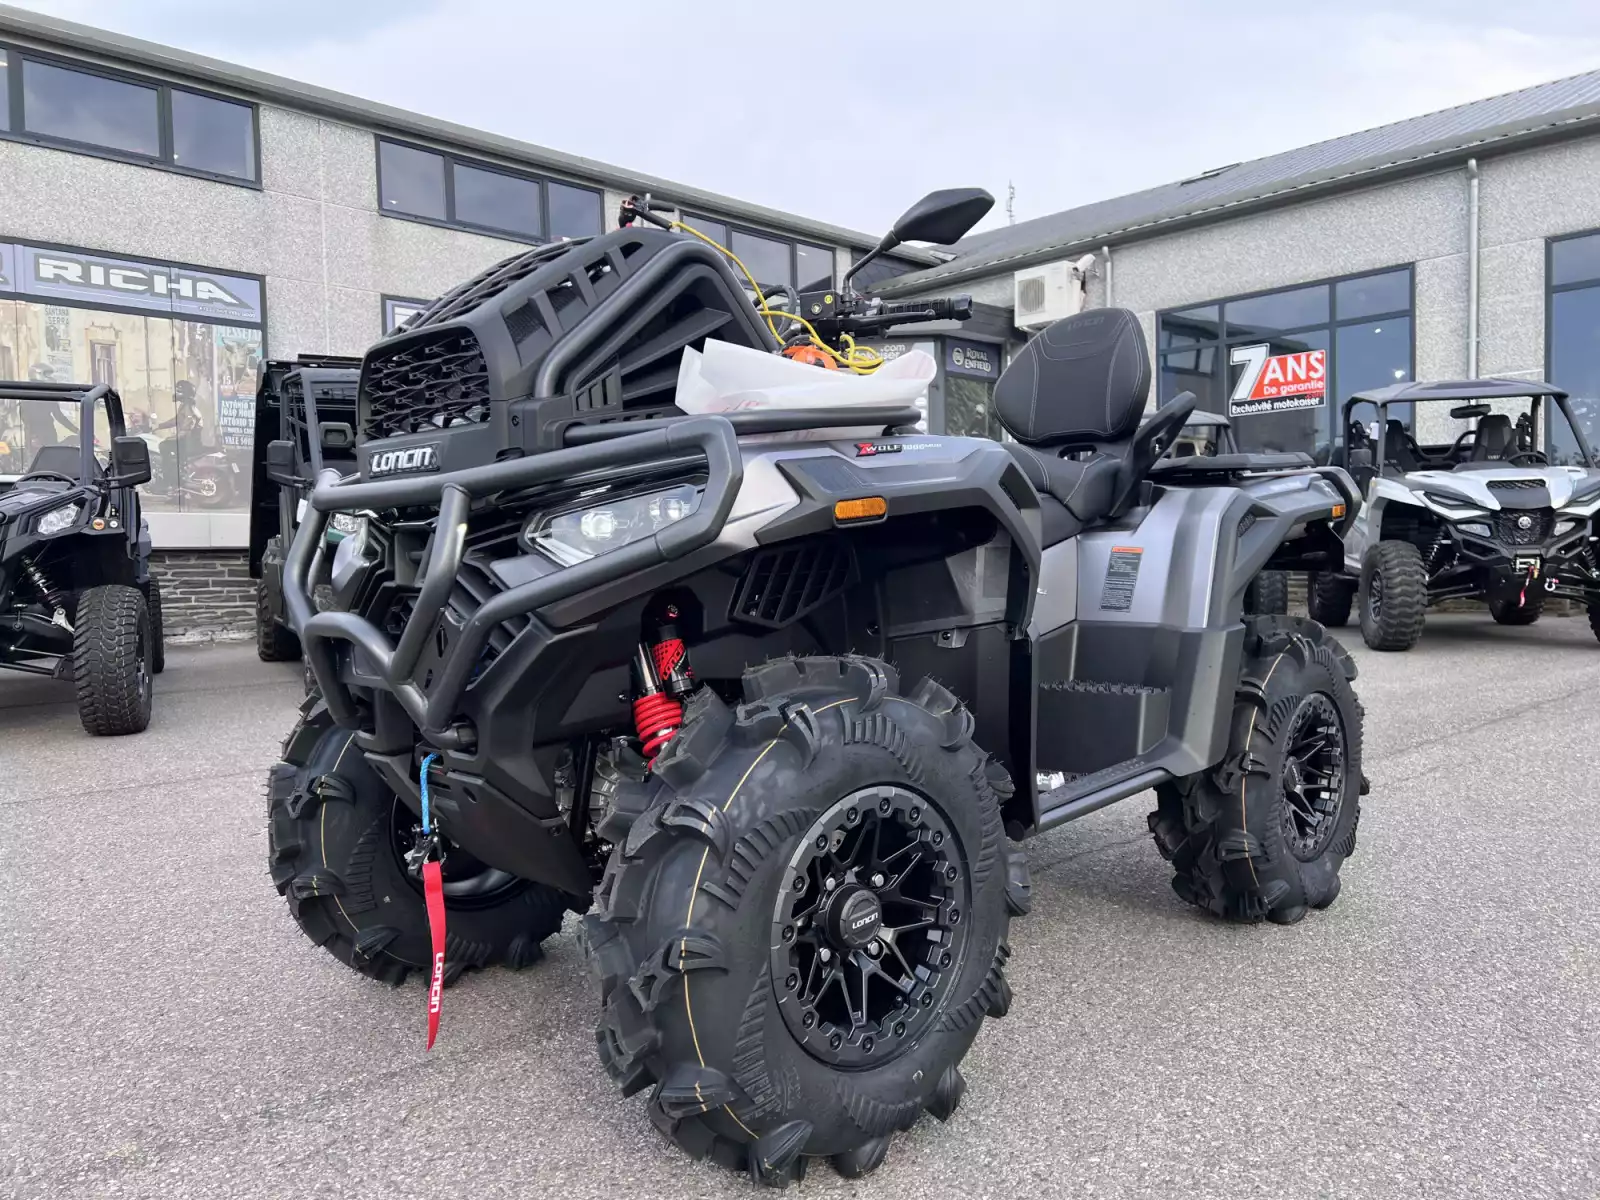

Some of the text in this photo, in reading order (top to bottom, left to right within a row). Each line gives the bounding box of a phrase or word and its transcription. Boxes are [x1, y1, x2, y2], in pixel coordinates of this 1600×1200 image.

[37, 256, 242, 306] RICHA
[880, 344, 906, 352] .com
[966, 347, 988, 361] ROYAL
[965, 359, 992, 373] ENFIELD
[1231, 345, 1324, 401] 7 ANS
[1263, 380, 1324, 396] De garantie
[1232, 398, 1320, 414] Exclusivité motokaiser
